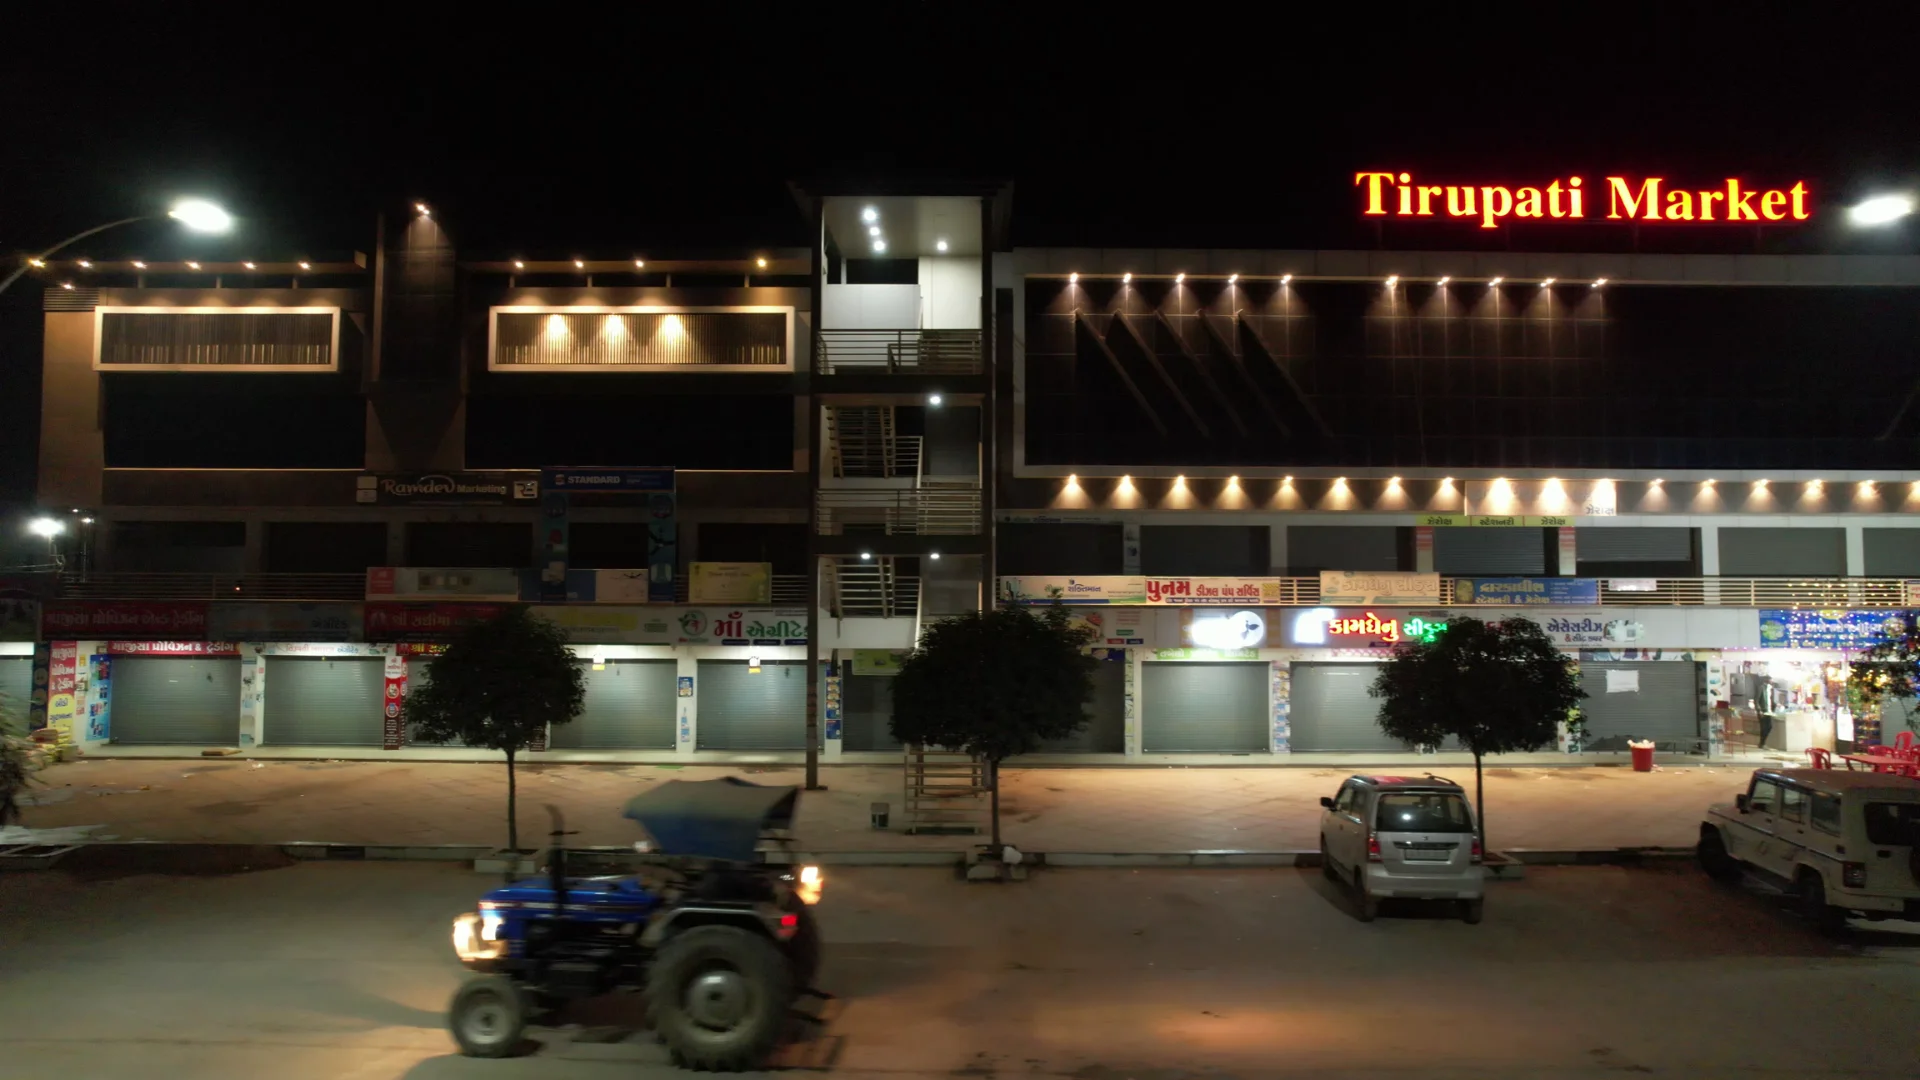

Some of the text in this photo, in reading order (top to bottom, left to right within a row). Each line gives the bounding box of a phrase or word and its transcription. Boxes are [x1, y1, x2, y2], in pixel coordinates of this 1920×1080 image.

[1355, 172, 1810, 228] Tirupati Market
[568, 475, 621, 485] STANDARD
[380, 475, 508, 496] Ramdev Marketing
[1427, 516, 1452, 526] ઝેરોક્ષ
[1480, 516, 1515, 526] સ્ટેશનરી
[1541, 516, 1566, 526] ઝેરોક્ષ
[1147, 580, 1191, 602] પુનમ
[1196, 583, 1219, 597] ડીઝલ
[1221, 584, 1235, 597] પંપ
[1236, 583, 1260, 597] સર્વિસ
[1342, 575, 1393, 597] કામધેનુ
[1515, 594, 1522, 603] &
[1328, 611, 1400, 642] કામધેનુ
[195, 643, 203, 652] &
